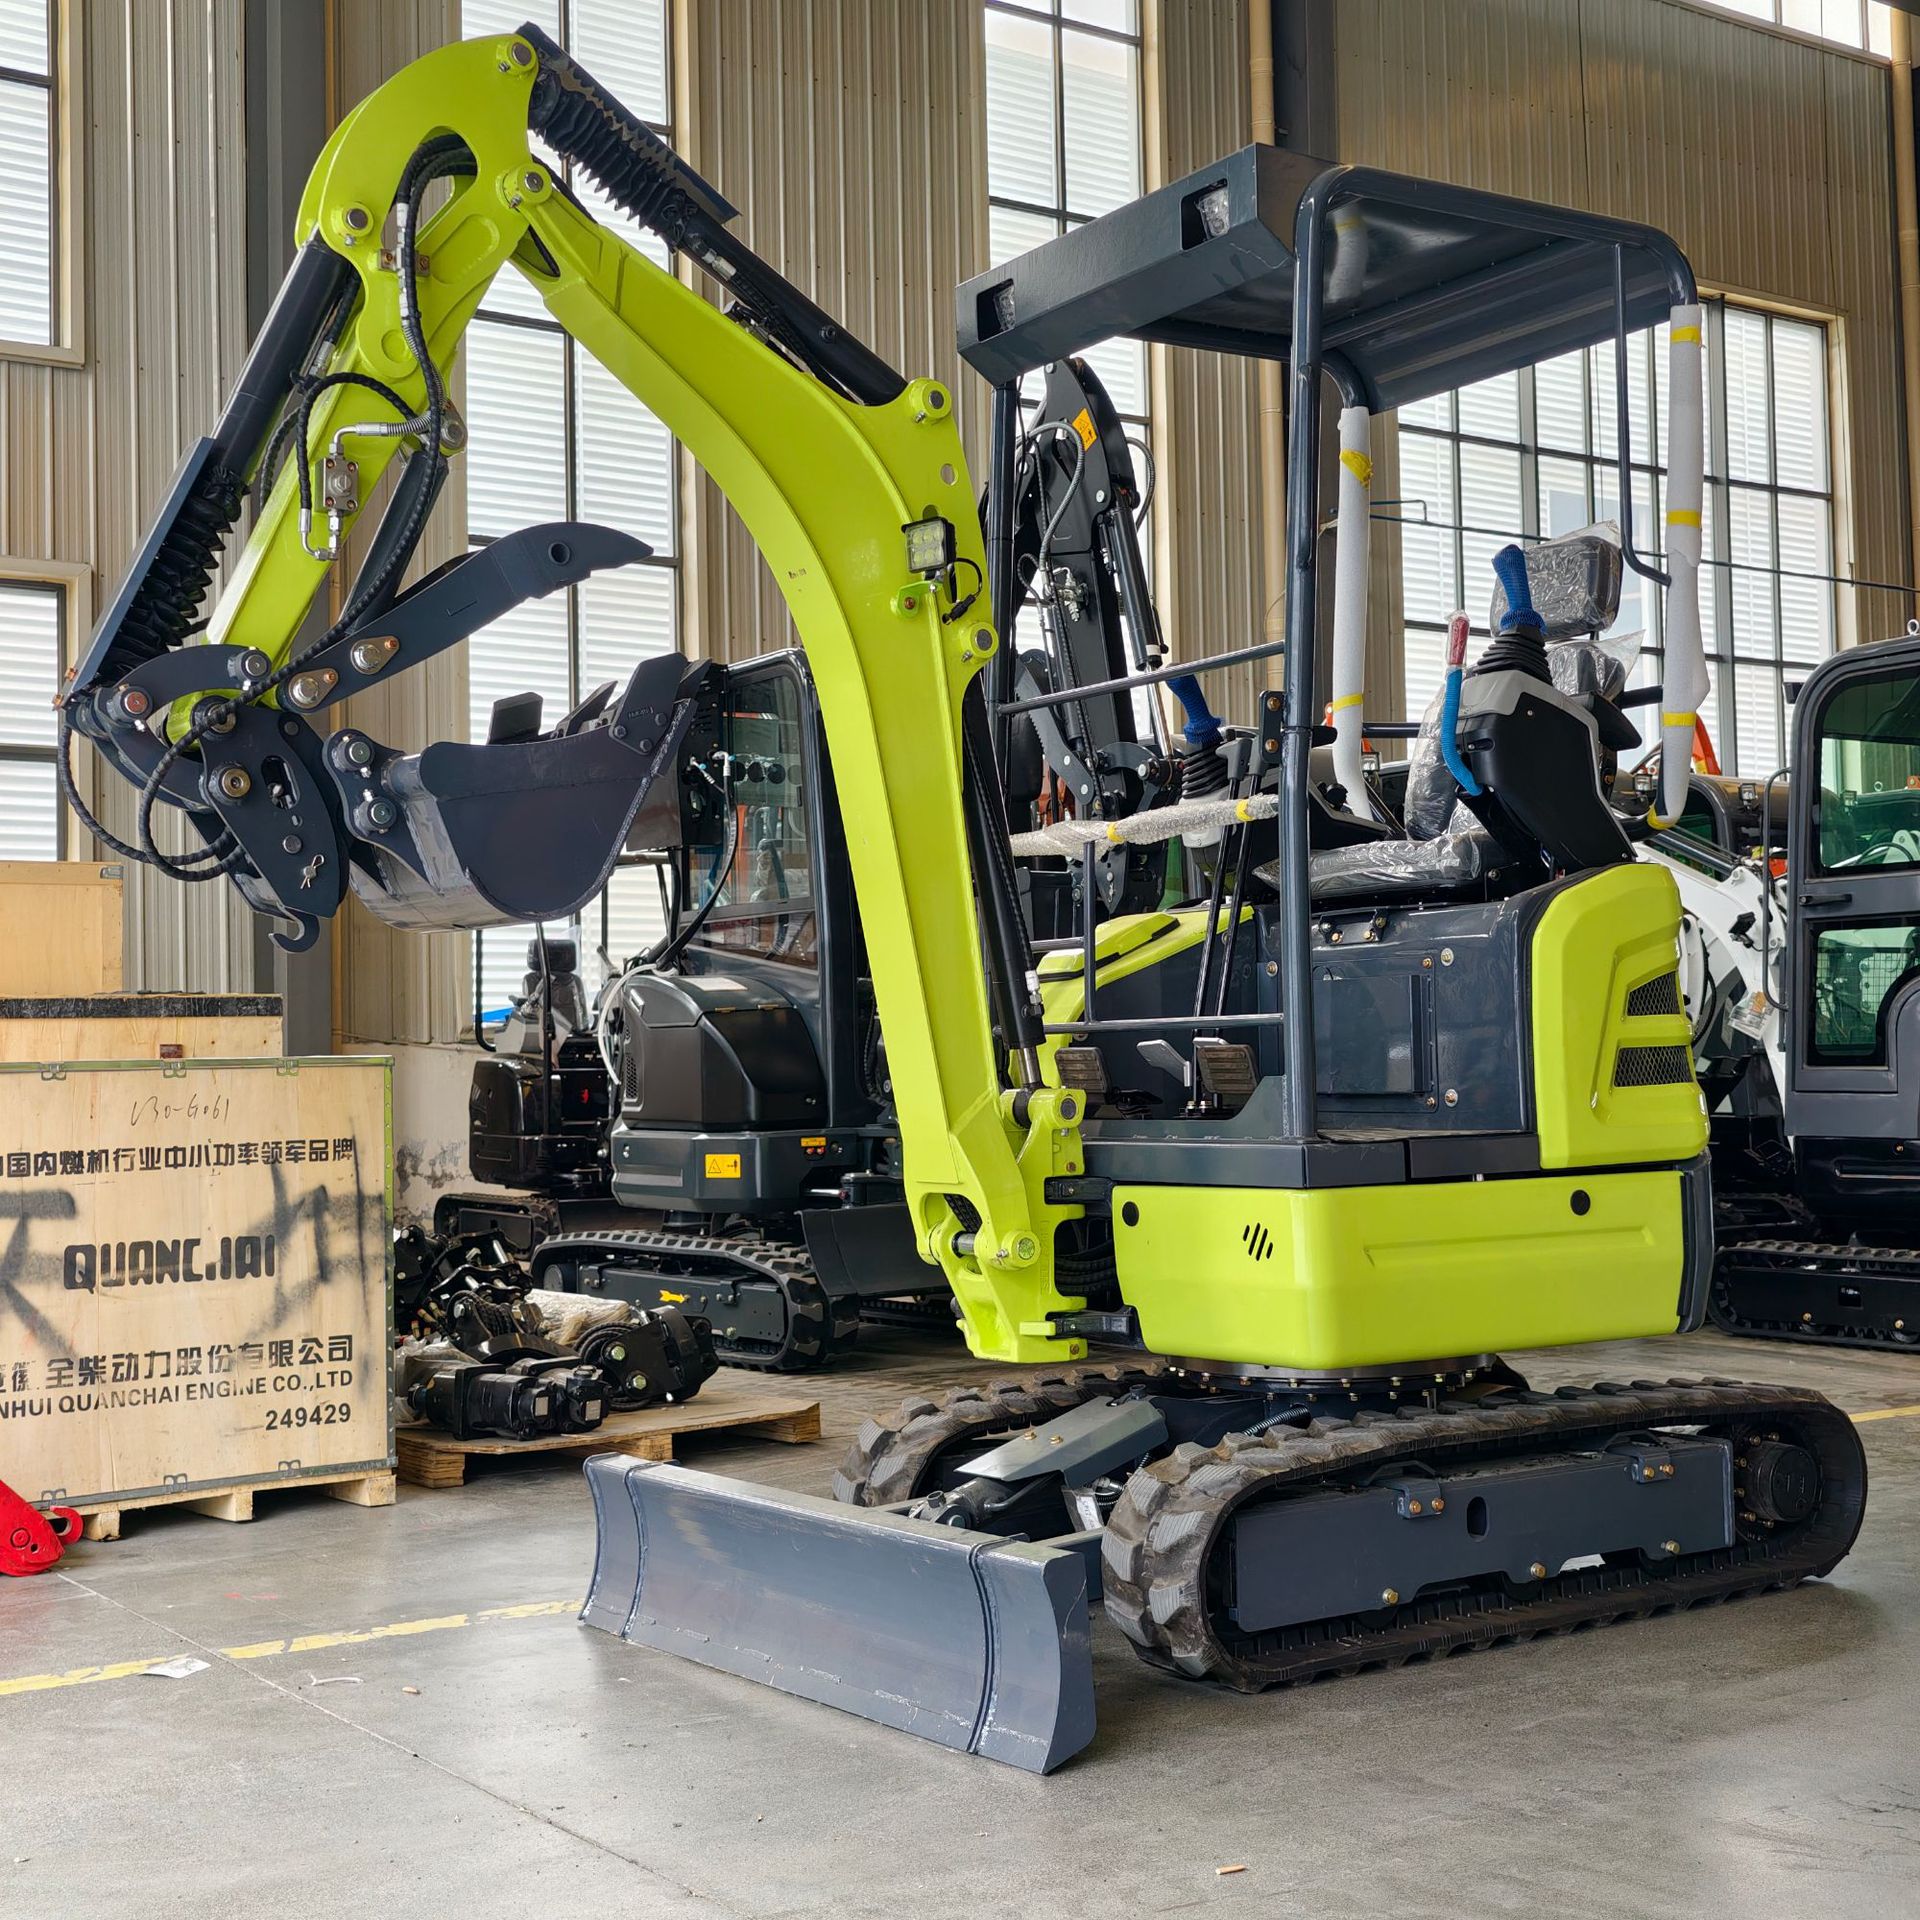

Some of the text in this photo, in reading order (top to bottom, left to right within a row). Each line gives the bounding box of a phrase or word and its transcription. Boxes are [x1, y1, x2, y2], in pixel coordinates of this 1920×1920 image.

[0, 1138, 353, 1177] 国内燃机行业中小功率领军品牌
[0, 1334, 353, 1393] 徽全柴动力股份有限公司
[58, 1385, 180, 1413] QUANCHAI
[186, 1377, 267, 1400] ENGINE
[273, 1370, 353, 1392] CO.,LTD
[265, 1403, 351, 1430] 249429
